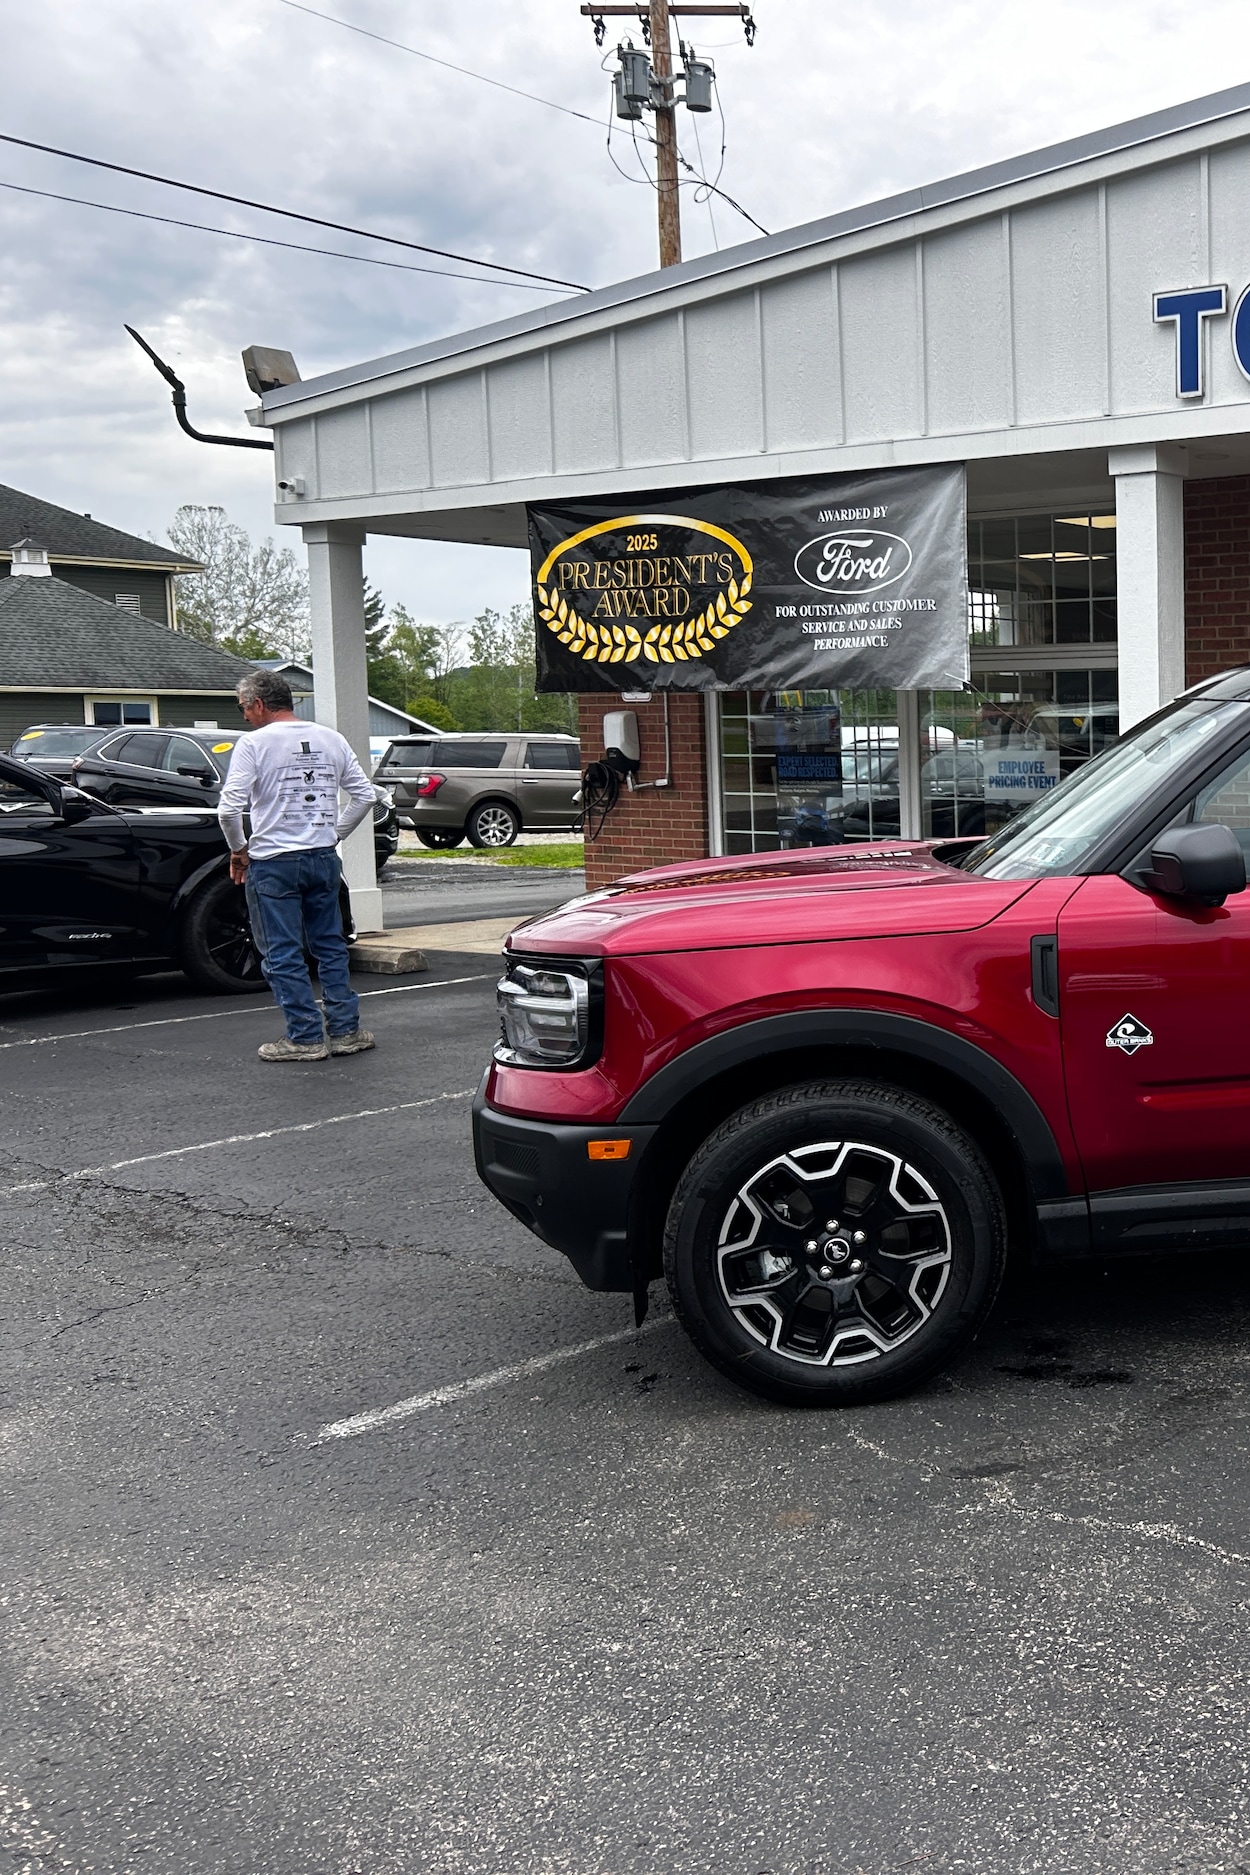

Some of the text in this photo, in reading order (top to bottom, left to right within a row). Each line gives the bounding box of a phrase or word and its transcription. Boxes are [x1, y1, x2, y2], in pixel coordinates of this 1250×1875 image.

[817, 505, 888, 523] AWARDED BY
[626, 534, 658, 551] 2025
[816, 539, 893, 583] Ford
[557, 551, 734, 591] PRESIDENT'S
[591, 586, 690, 618] AWARD
[775, 599, 937, 618] FOR OUTSTANDING CUSTOMER
[802, 617, 903, 634] SERVICE AND SALES
[813, 635, 888, 651] PERFORMANCE
[778, 756, 803, 767] EXPERT
[998, 761, 1045, 774] EMPLOYEE
[798, 766, 838, 778] RESPECTED.
[989, 775, 1057, 789] PRICING EVENT
